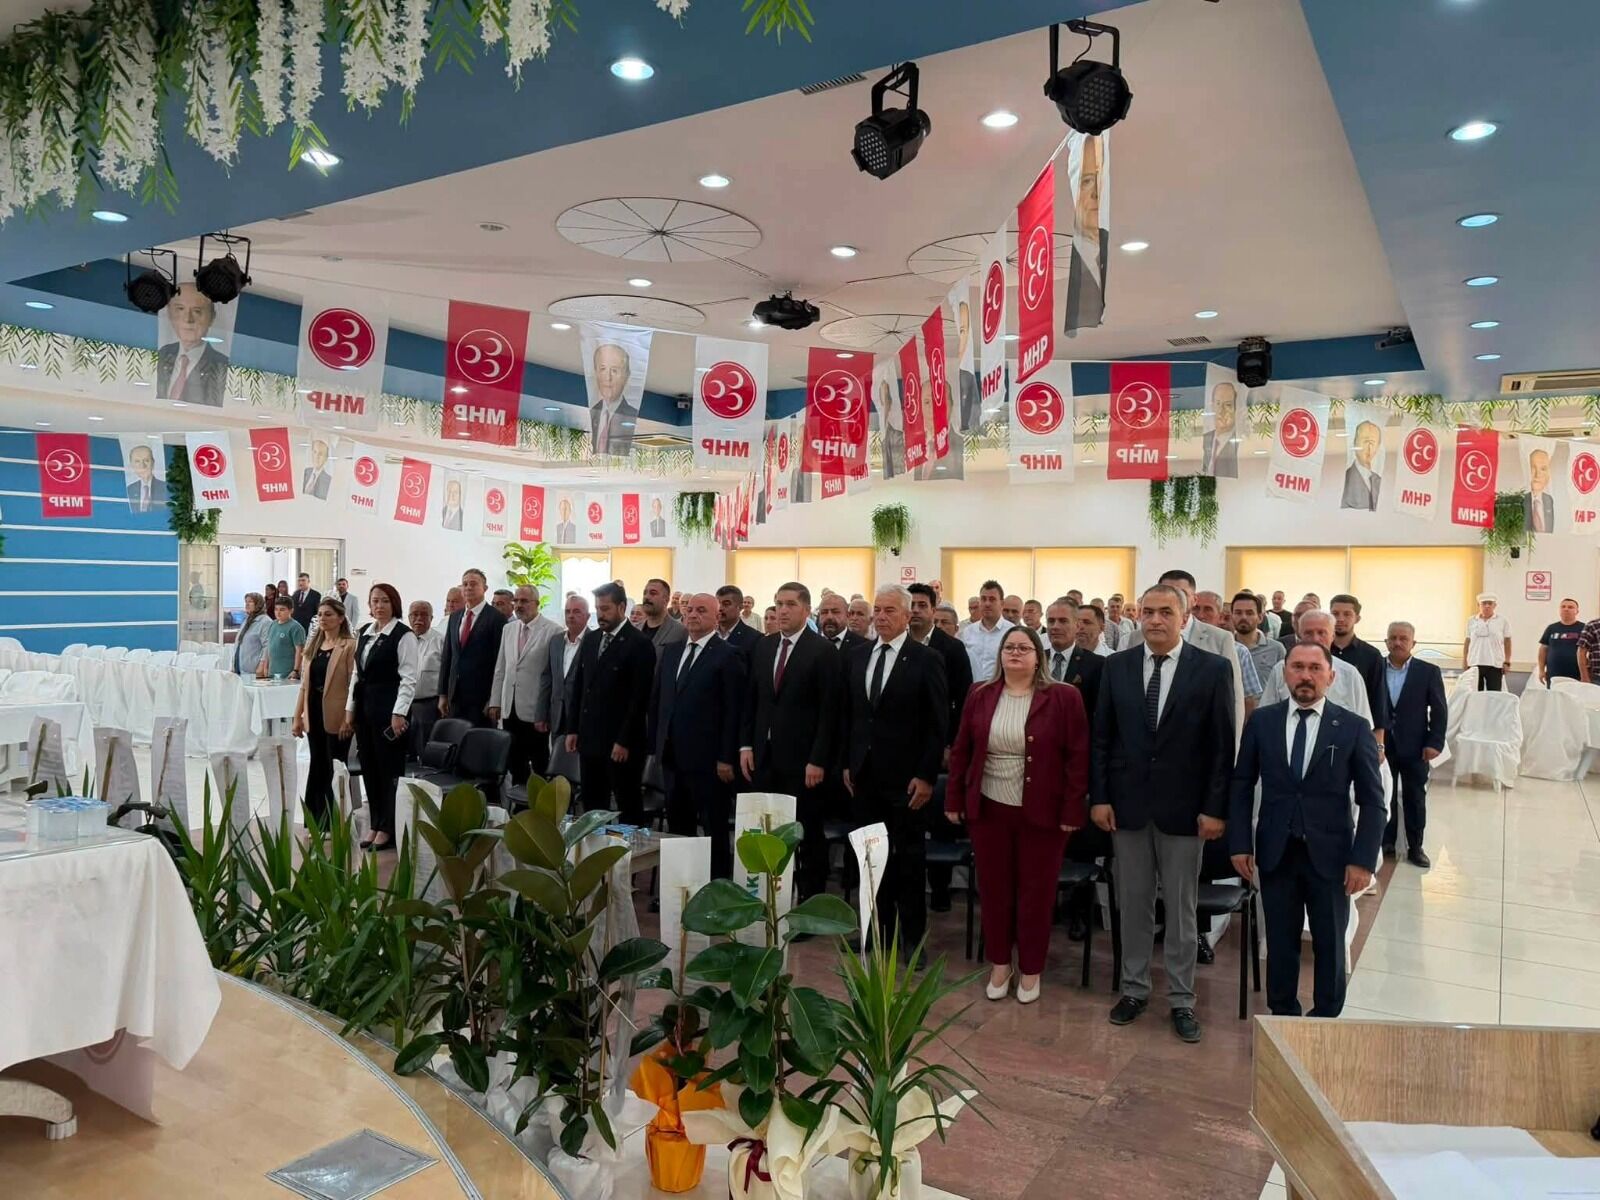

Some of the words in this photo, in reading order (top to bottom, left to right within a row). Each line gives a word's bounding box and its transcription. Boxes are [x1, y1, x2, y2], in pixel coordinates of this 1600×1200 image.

[1022, 334, 1048, 375] MHP
[1401, 489, 1432, 507] MHP
[1457, 506, 1488, 523] MHP
